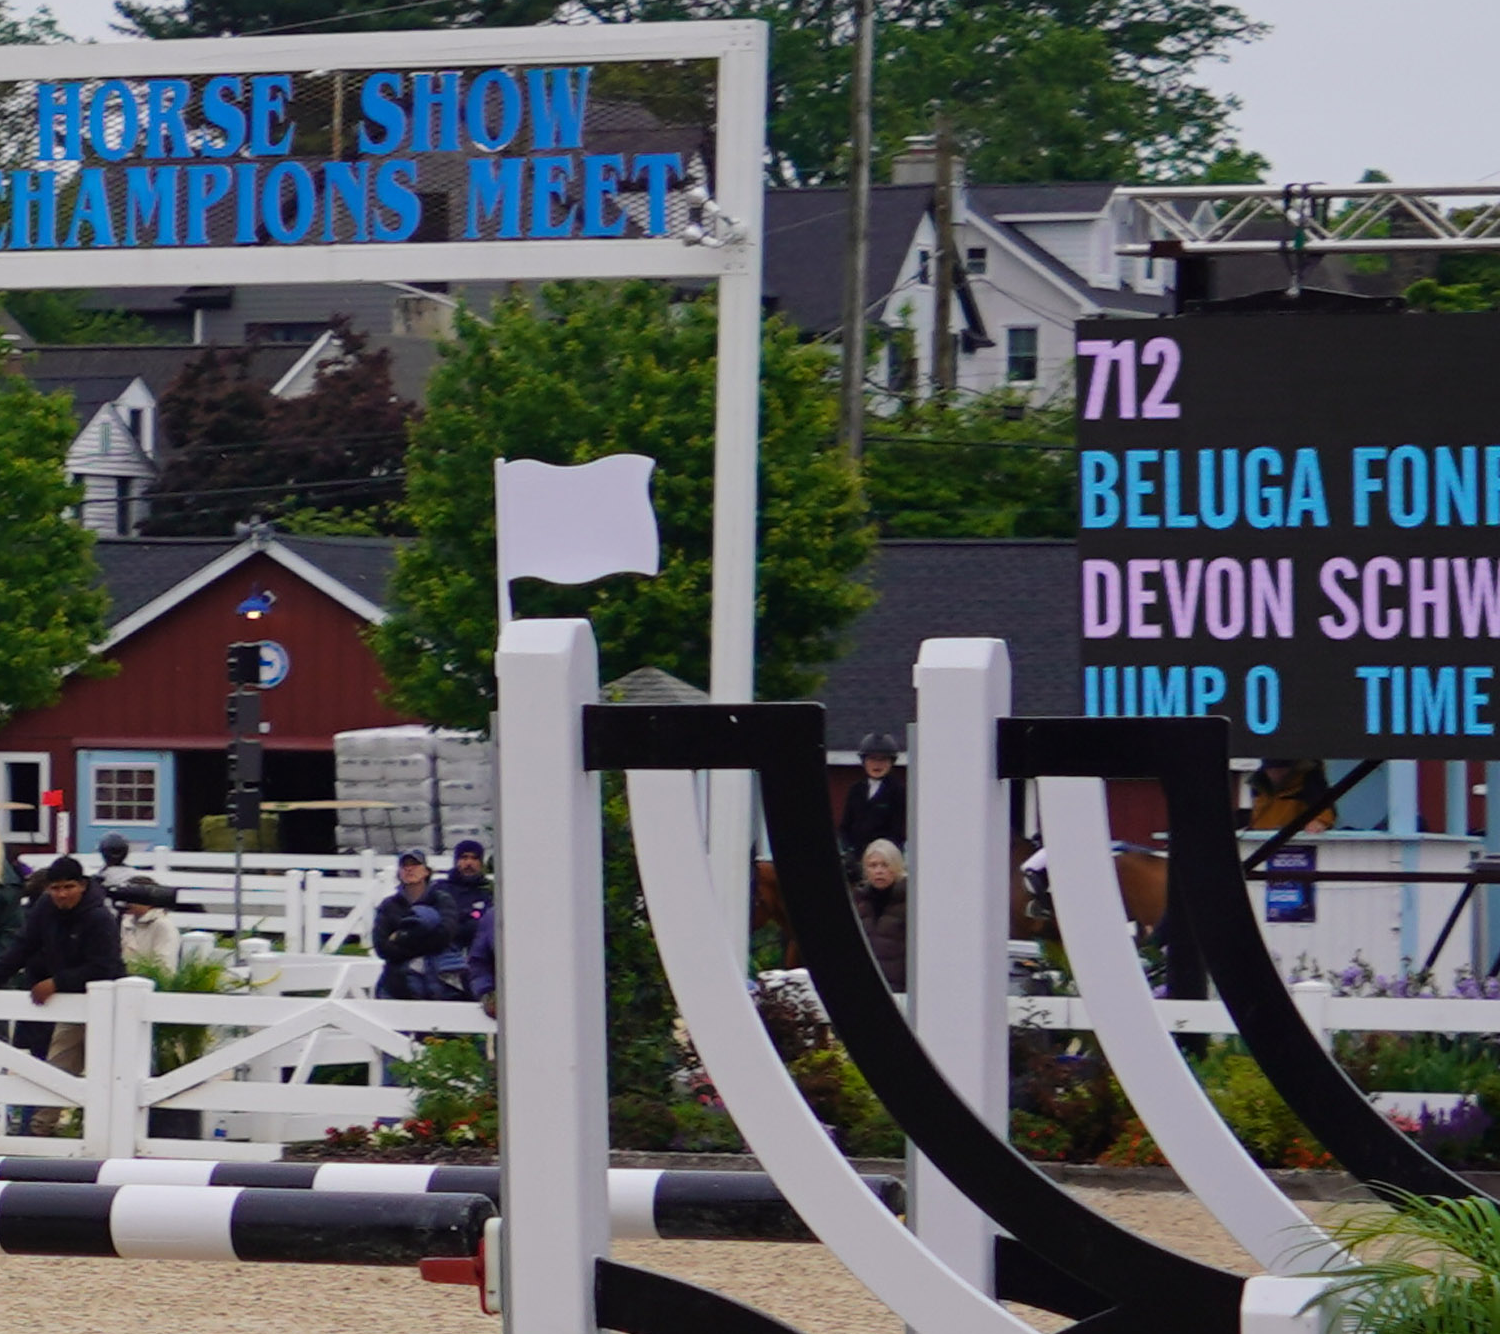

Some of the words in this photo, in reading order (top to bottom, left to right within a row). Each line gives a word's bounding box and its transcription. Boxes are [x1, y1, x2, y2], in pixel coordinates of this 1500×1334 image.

[38, 75, 293, 163] HORSE
[358, 66, 592, 155] SHOW
[464, 152, 683, 240] MEET
[1077, 337, 1181, 420] 712
[1081, 447, 1329, 529] BELUGA
[1082, 557, 1294, 640] DEVON
[1318, 556, 1500, 640] SCHW
[1355, 665, 1495, 735] TIME
